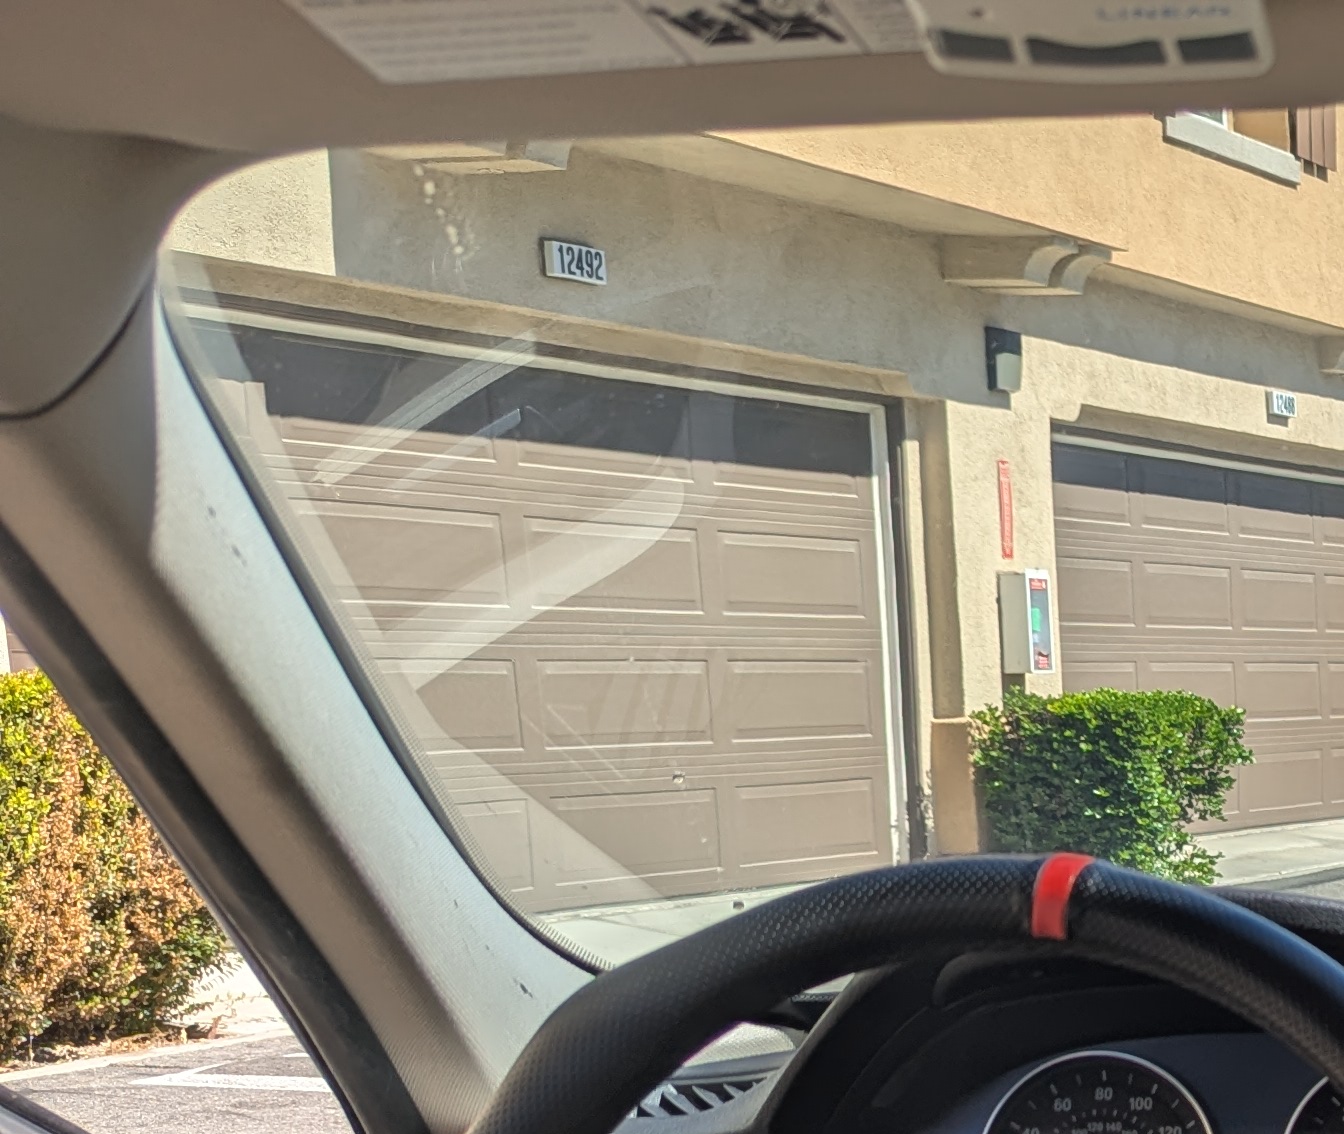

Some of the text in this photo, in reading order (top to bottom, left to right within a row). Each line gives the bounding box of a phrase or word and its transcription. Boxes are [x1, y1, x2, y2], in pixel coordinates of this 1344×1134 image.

[558, 244, 604, 281] 12492
[1095, 1086, 1113, 1101] 80
[1054, 1097, 1072, 1112] 60
[1129, 1096, 1153, 1111] 100
